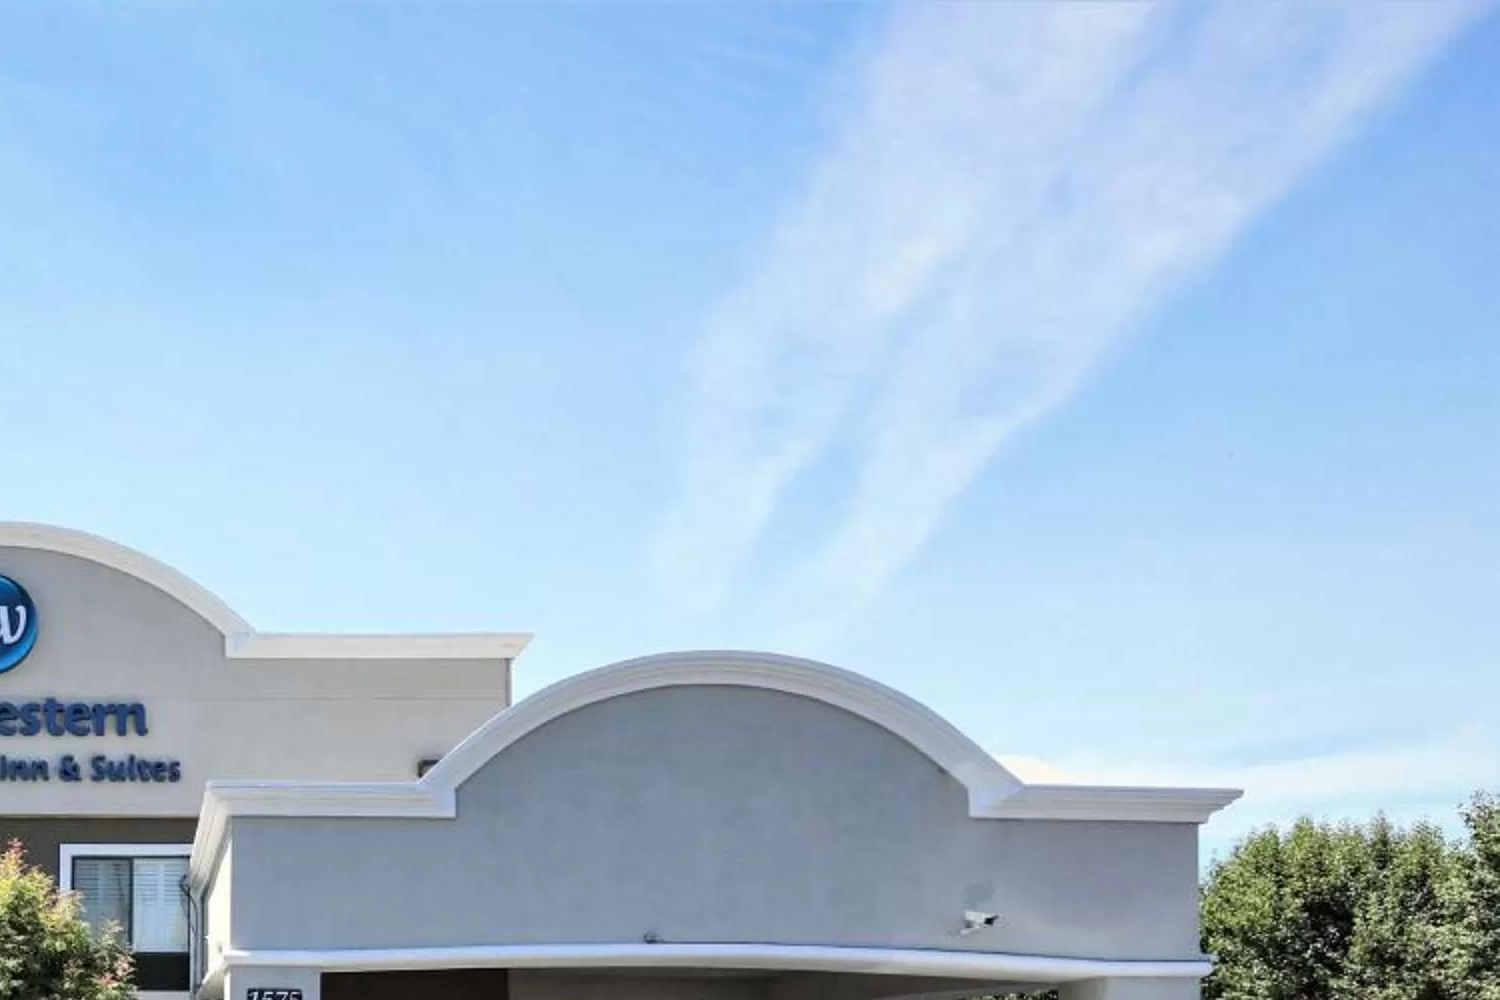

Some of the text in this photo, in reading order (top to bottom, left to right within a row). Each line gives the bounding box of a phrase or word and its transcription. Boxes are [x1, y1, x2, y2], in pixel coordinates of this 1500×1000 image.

[0, 754, 50, 783] Inn
[57, 754, 83, 784] &
[89, 753, 181, 783] Suites
